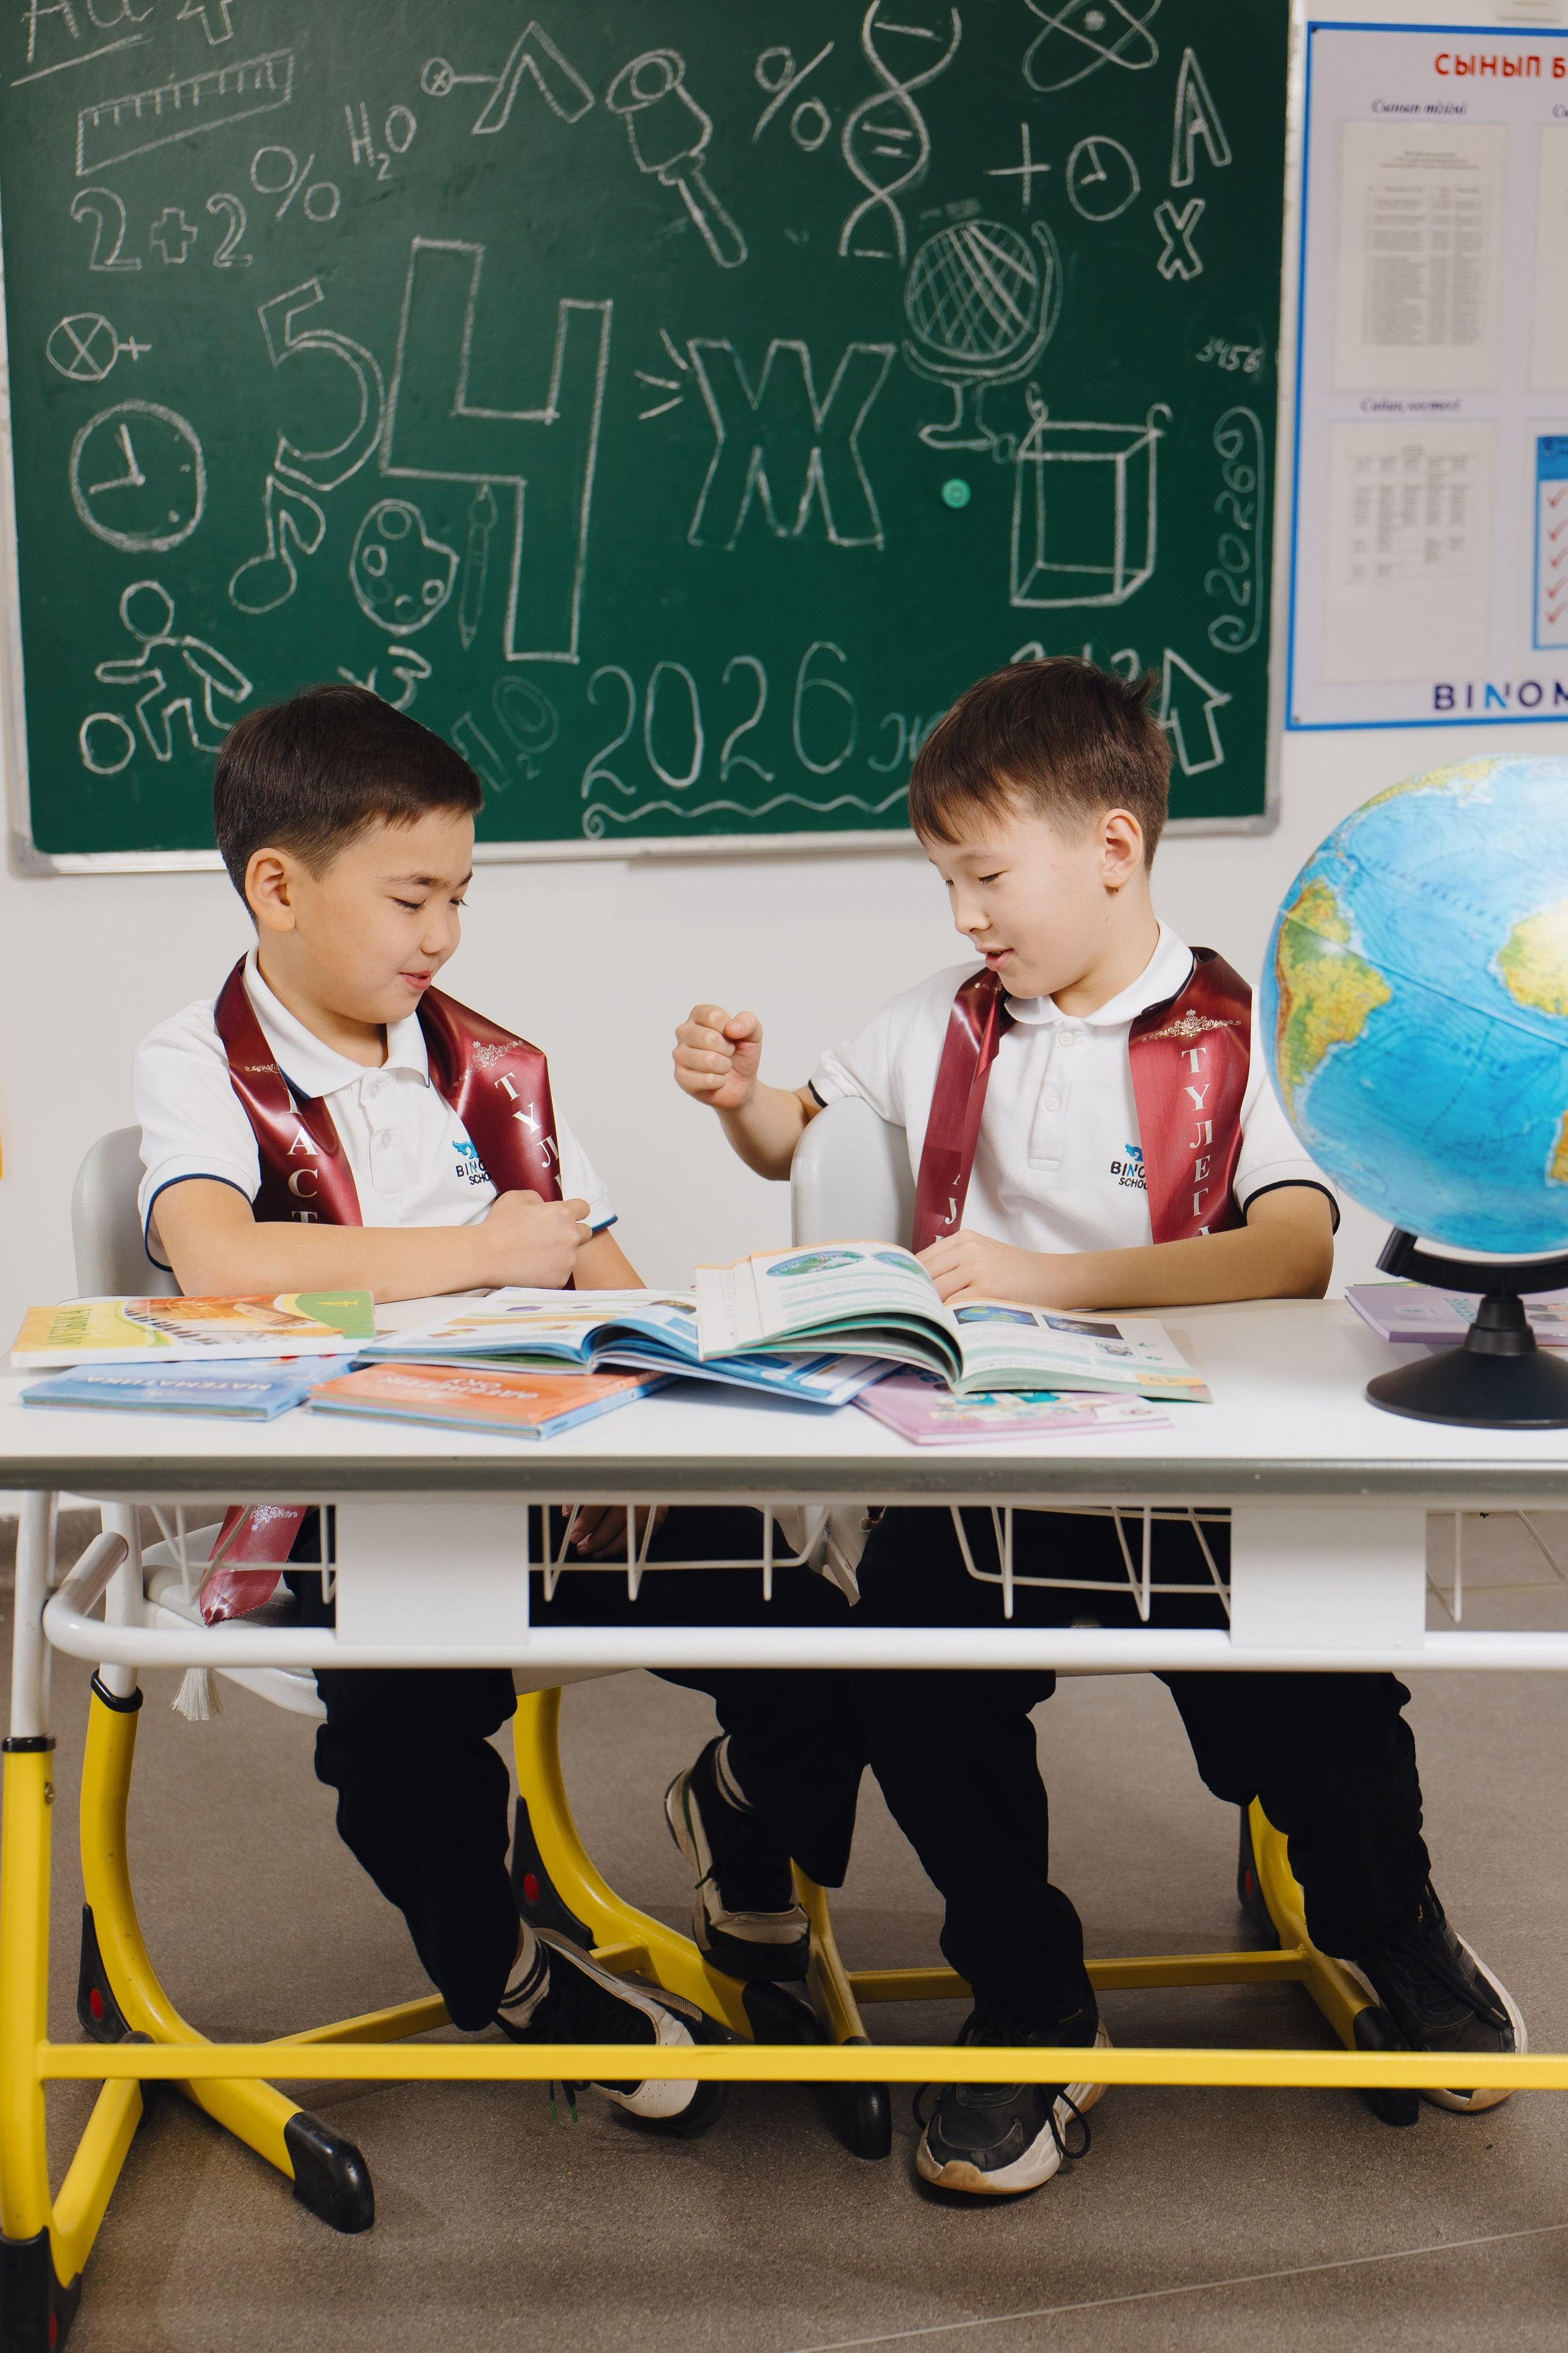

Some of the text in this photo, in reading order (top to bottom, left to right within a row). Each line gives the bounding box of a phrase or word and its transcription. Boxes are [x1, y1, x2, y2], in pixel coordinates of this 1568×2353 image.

[1434, 53, 1541, 77] СЫНЫП
[380, 235, 897, 664] 4 Ж
[581, 641, 856, 799] 2026
[494, 1071, 563, 1193] ТҮЛ
[1182, 1047, 1214, 1236] ТҮЛЕГ
[86, 1375, 273, 1391] МАТЕМАТИКА
